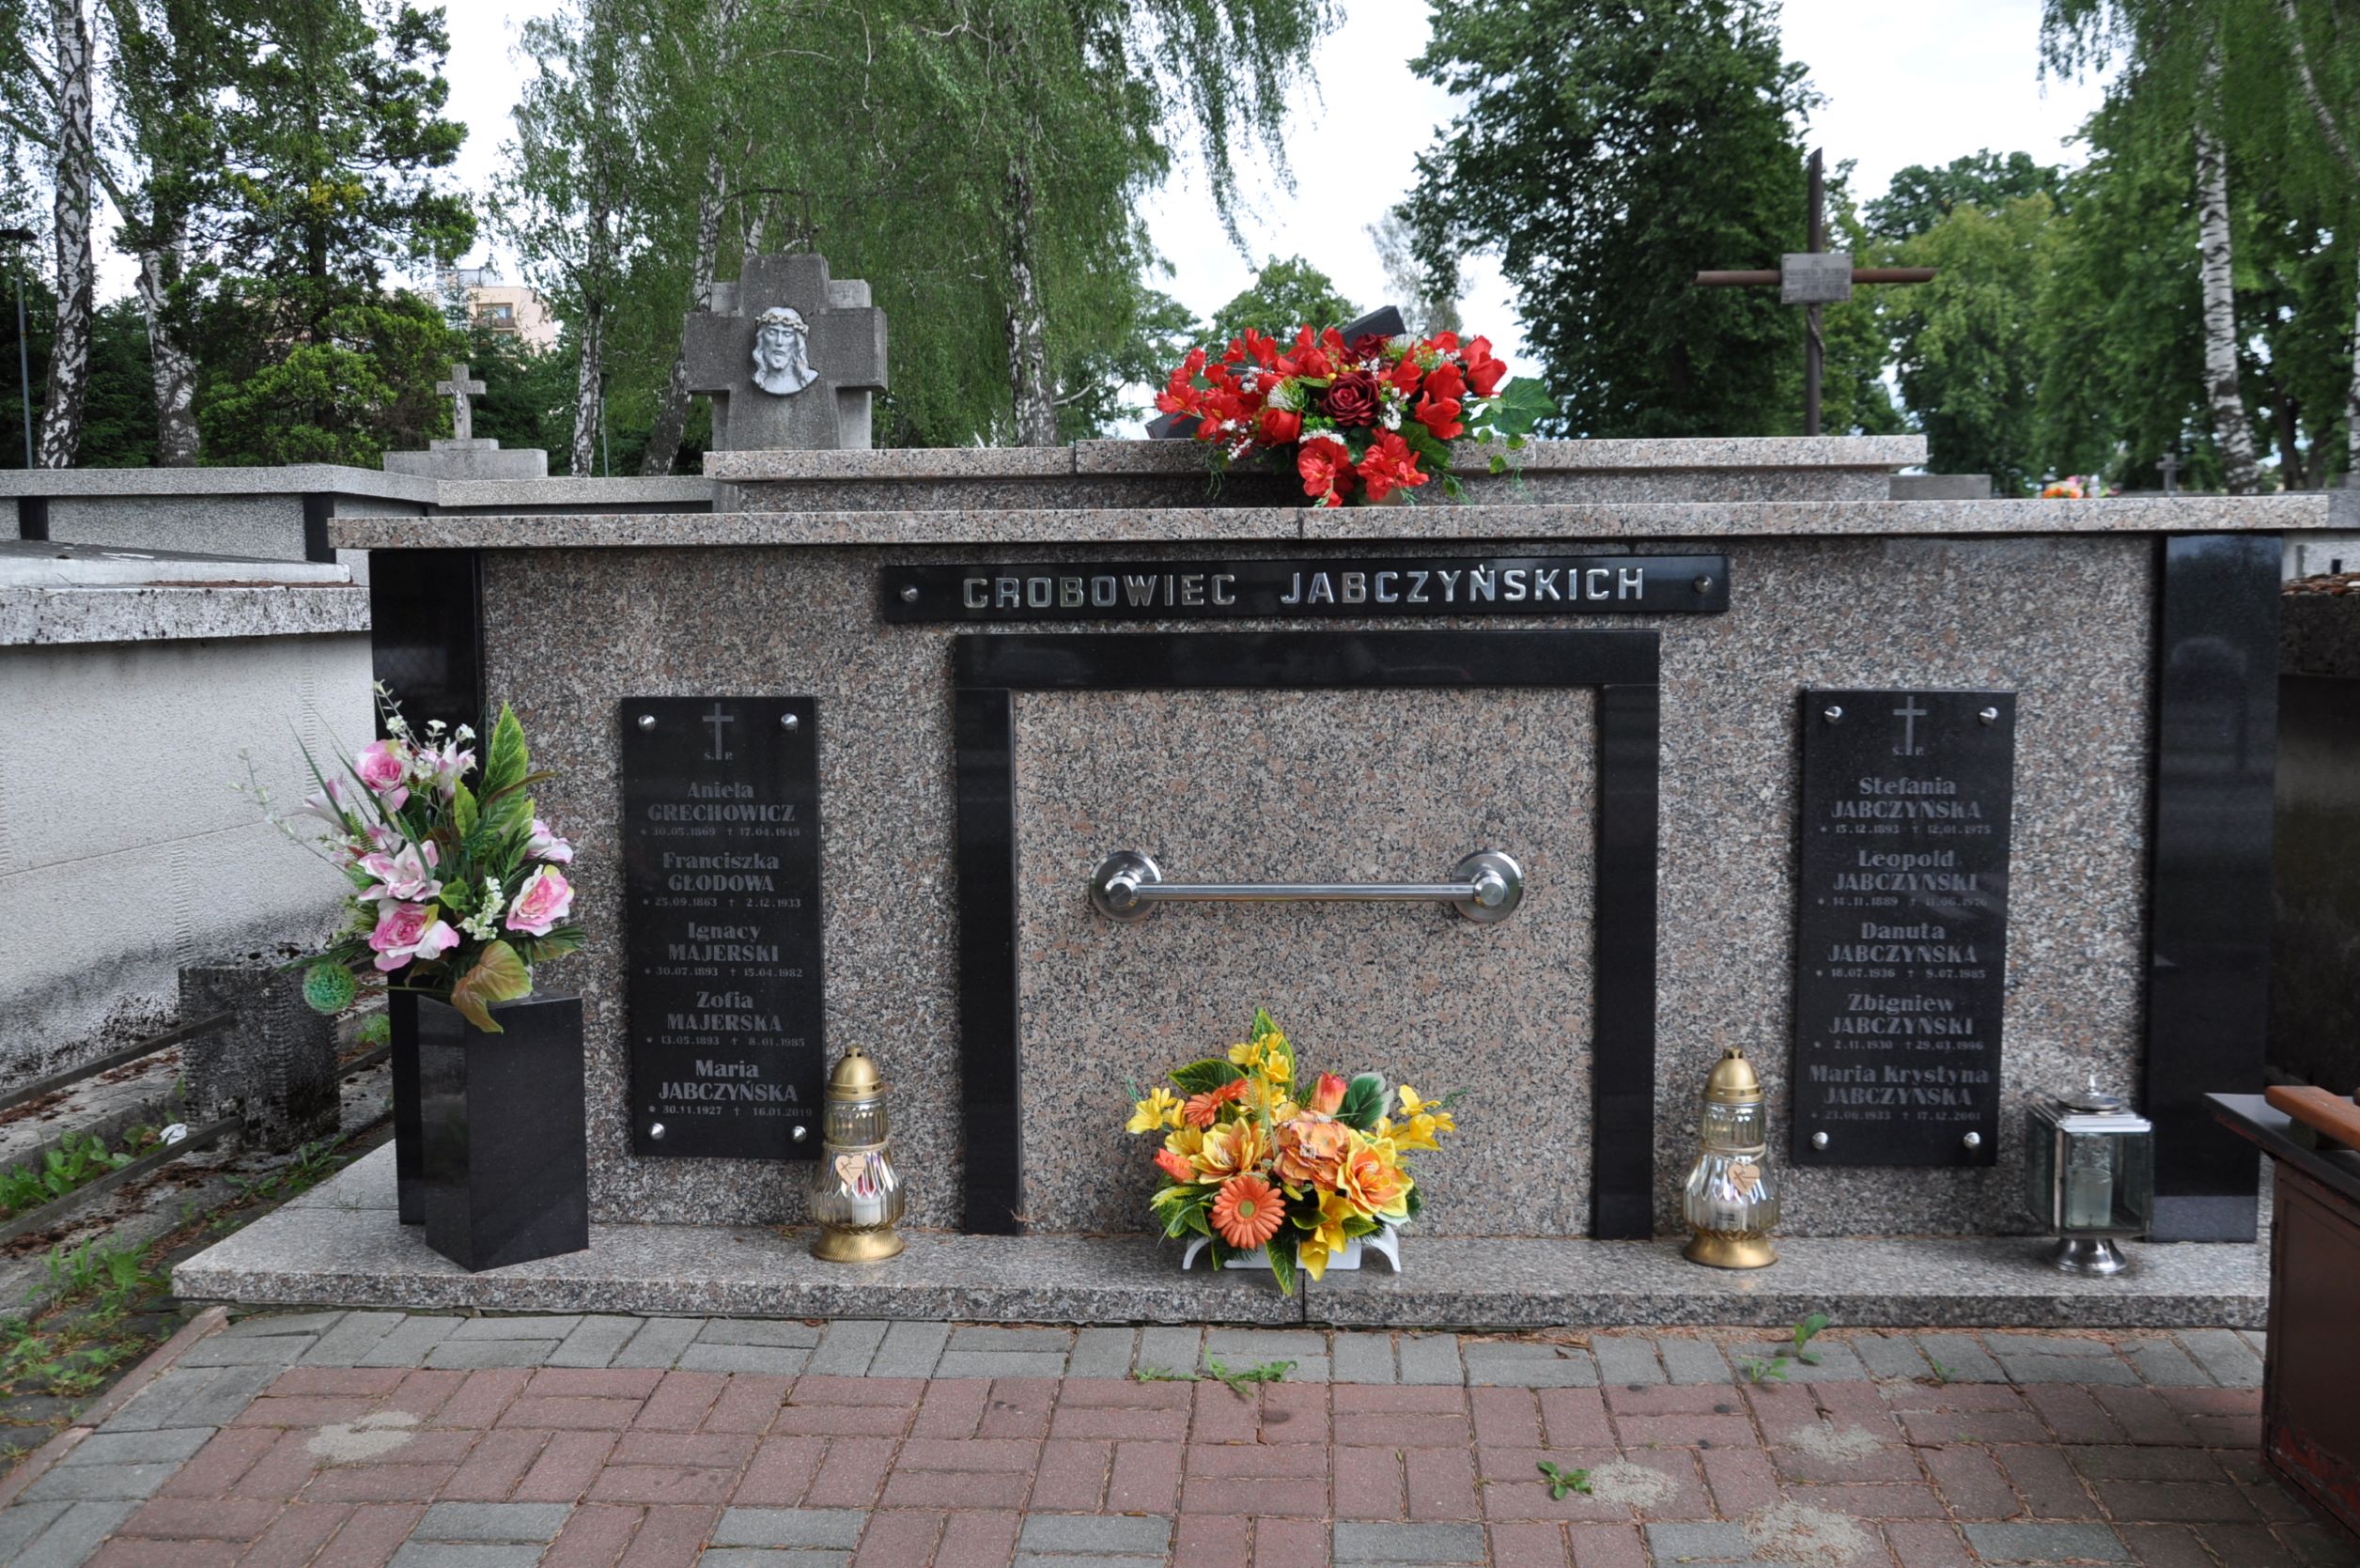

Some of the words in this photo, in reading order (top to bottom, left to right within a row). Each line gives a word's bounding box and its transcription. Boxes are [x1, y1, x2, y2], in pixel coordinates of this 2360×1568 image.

[963, 573, 1237, 610] GROBOWIEC
[1280, 564, 1644, 604] JABCZYŃSKICH
[687, 782, 753, 798] Aniela
[1859, 777, 1956, 795] Stefania
[647, 804, 796, 822] GRECHOWICZ
[1831, 799, 1981, 818] JABCZYŃSKA
[662, 851, 780, 870] Franciszka
[1858, 850, 1955, 871] Leopold
[668, 875, 775, 893] GŁODOWA
[688, 922, 761, 941] Ignacy
[1861, 922, 1946, 939] Danuta
[668, 944, 779, 962] MAJERSKI
[1828, 943, 1978, 963] JABCZYŃSKA
[696, 991, 753, 1008] Zofia
[1847, 993, 1955, 1015] Zbigniew
[667, 1014, 783, 1032] MAJERSKA
[695, 1060, 759, 1078] Maria
[1809, 1065, 1876, 1082] Maria
[1884, 1065, 1989, 1085] Krystyna
[659, 1080, 798, 1102] JABCZYŃSKA
[662, 1106, 722, 1115] 30.11.1927
